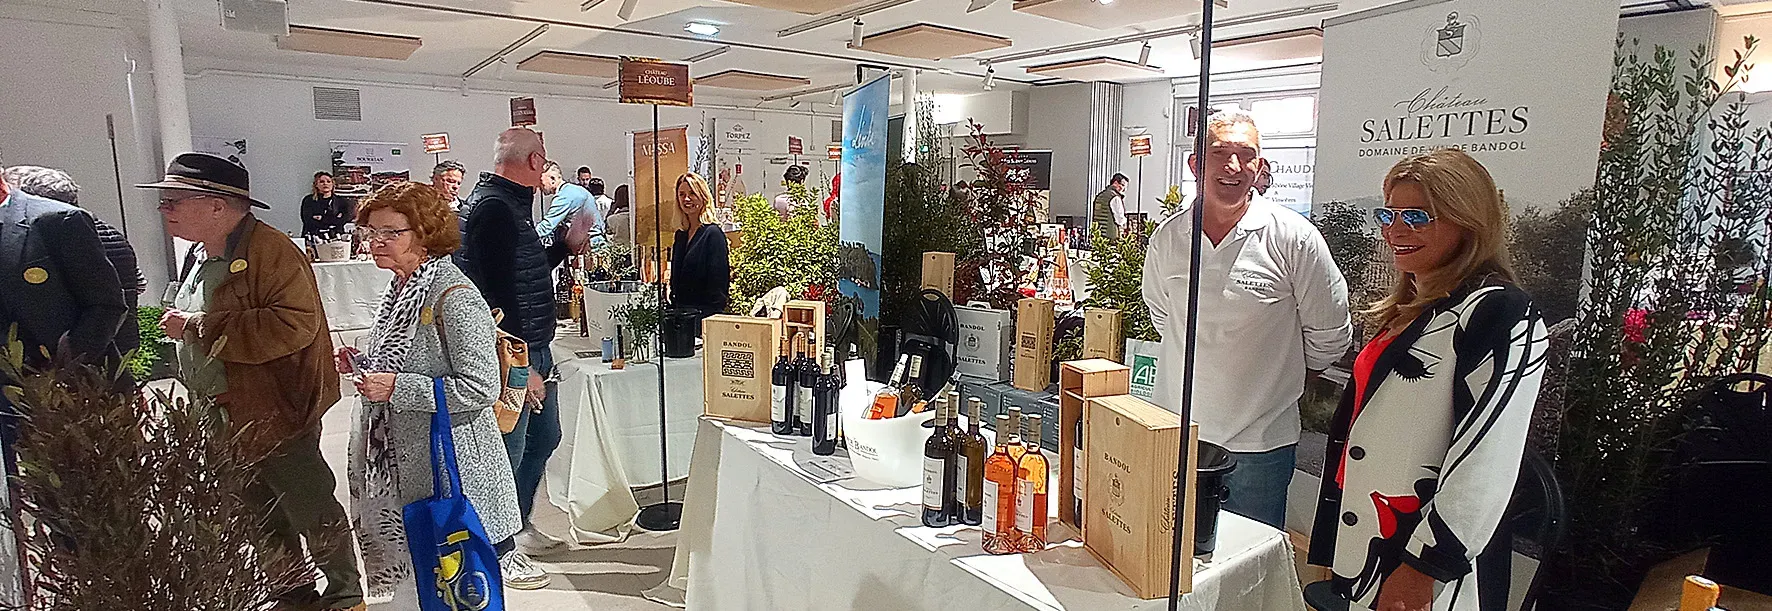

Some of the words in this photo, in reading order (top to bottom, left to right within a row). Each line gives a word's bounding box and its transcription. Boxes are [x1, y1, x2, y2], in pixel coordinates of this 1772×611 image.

[638, 75, 675, 86] LÉOUBE
[1394, 85, 1488, 118] Château
[1360, 106, 1528, 143] SALETTES
[642, 142, 676, 156] MSSA
[1359, 146, 1408, 157] DOMAINE
[1411, 145, 1426, 155] DE
[1472, 141, 1527, 152] BANDOL
[960, 323, 985, 331] BANDOL
[722, 391, 755, 400] SALETTES
[1104, 452, 1131, 474] BANDOL
[1102, 508, 1132, 535] SALETTES
